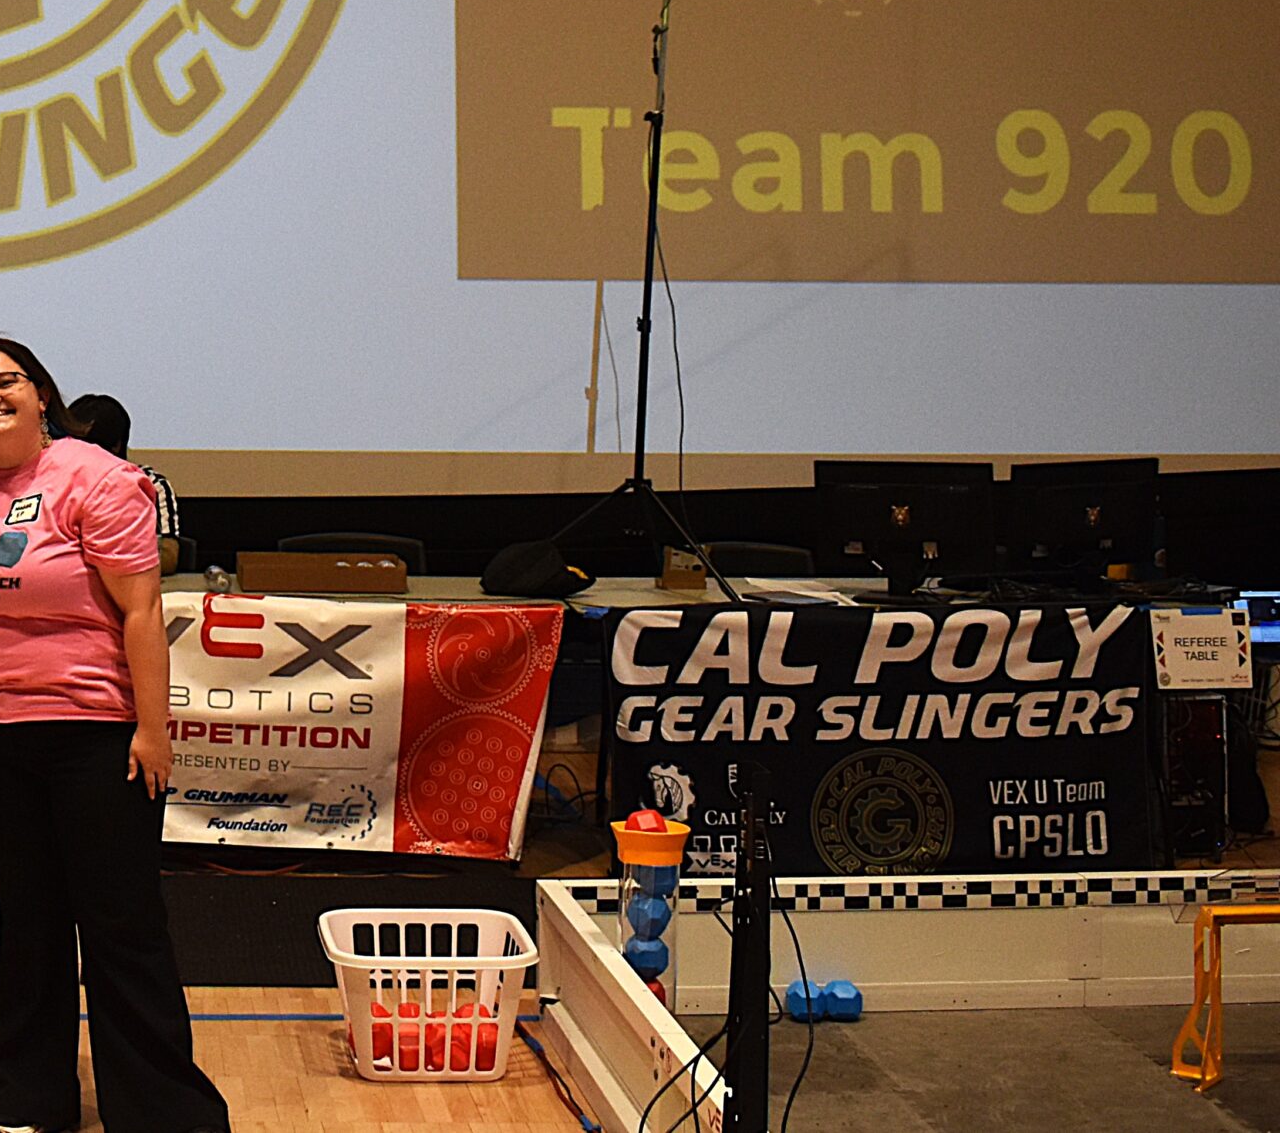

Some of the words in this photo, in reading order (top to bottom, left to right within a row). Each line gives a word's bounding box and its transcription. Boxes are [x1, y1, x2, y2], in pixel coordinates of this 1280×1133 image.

[551, 107, 944, 213] Team
[995, 108, 1252, 215] 920
[611, 610, 818, 685] CAL
[853, 605, 1135, 684] POLY
[1174, 637, 1228, 647] REFEREE
[1184, 651, 1219, 661] TABLE
[616, 695, 795, 742] GEAR
[815, 687, 1140, 740] SLINGERS
[268, 758, 291, 773] BY
[184, 789, 289, 804] GRUMMAN
[989, 780, 1028, 804] VEX
[1035, 779, 1047, 804] U
[1053, 779, 1105, 803] Team
[207, 817, 288, 832] Foundation
[304, 816, 360, 825] Foundation
[993, 810, 1109, 859] CPSLO
